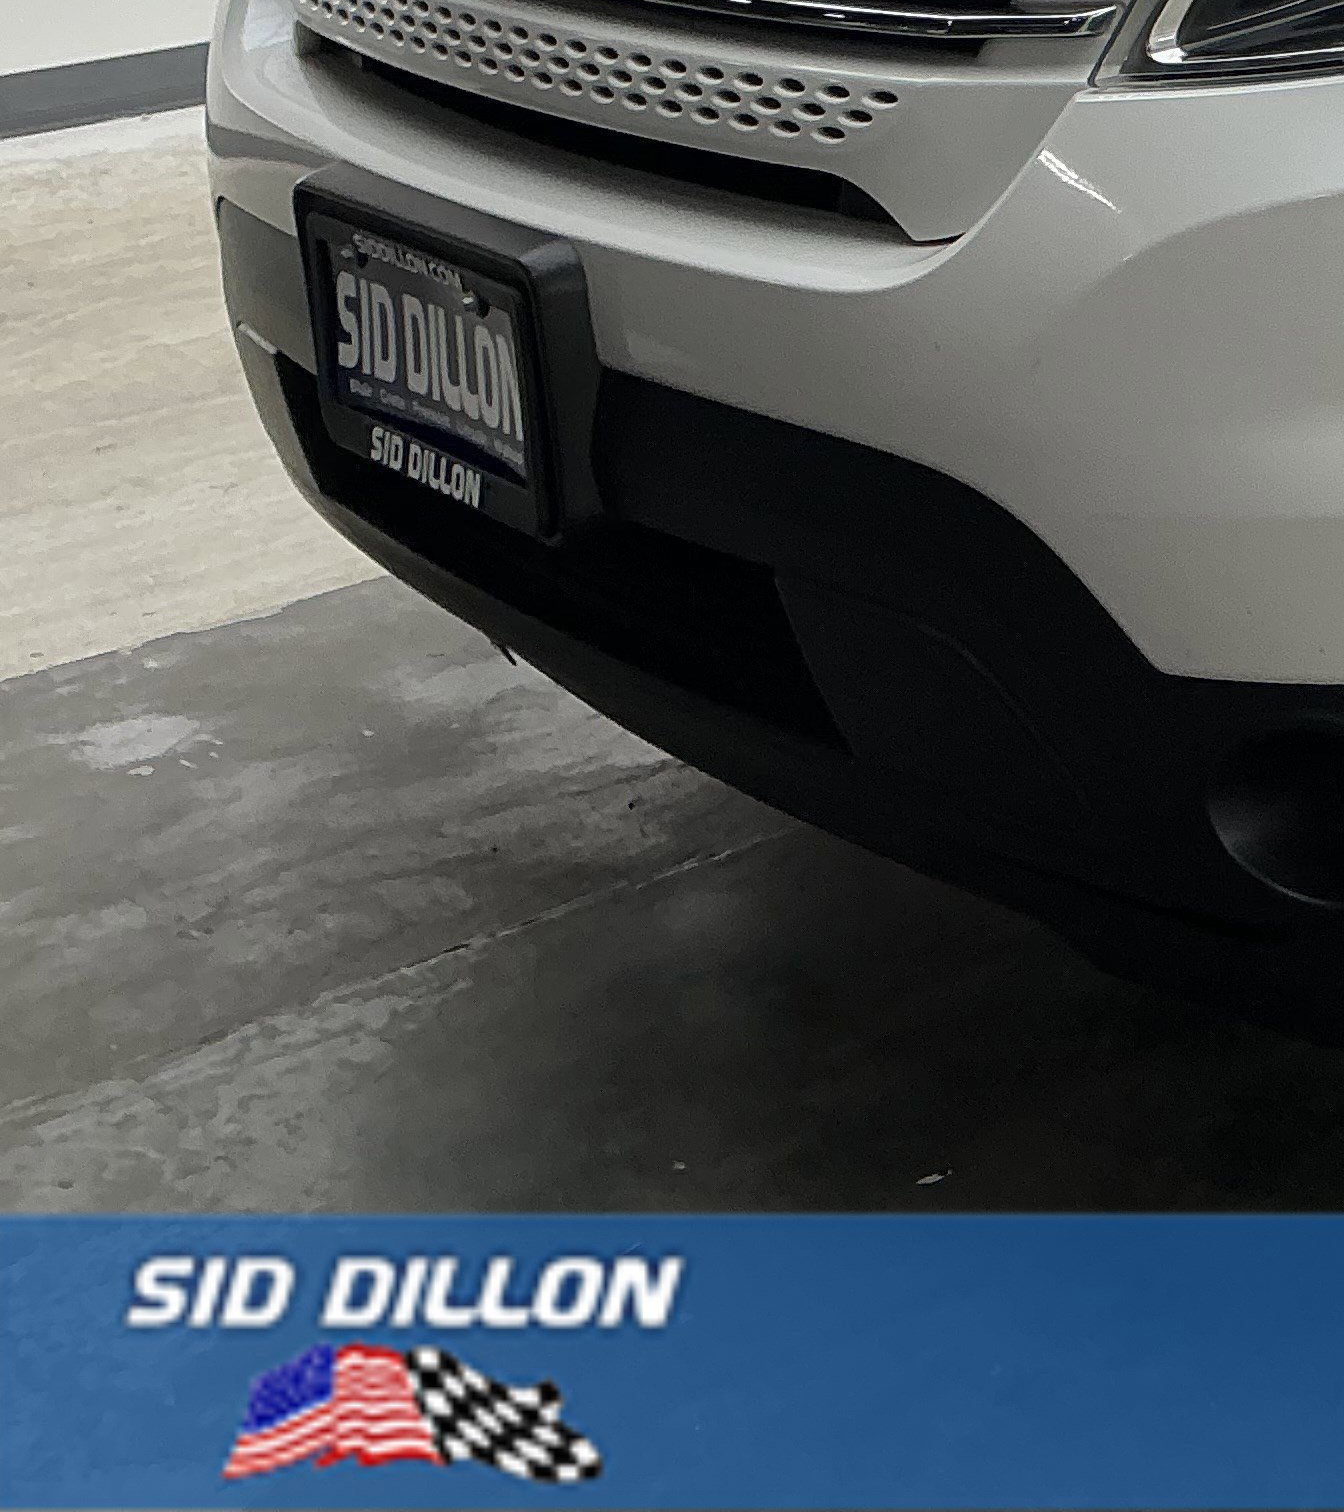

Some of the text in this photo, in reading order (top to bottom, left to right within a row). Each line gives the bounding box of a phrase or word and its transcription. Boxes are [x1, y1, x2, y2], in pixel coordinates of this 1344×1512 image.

[336, 271, 397, 383] SID
[402, 293, 524, 442] DILLON
[370, 425, 481, 509] SID DILLON
